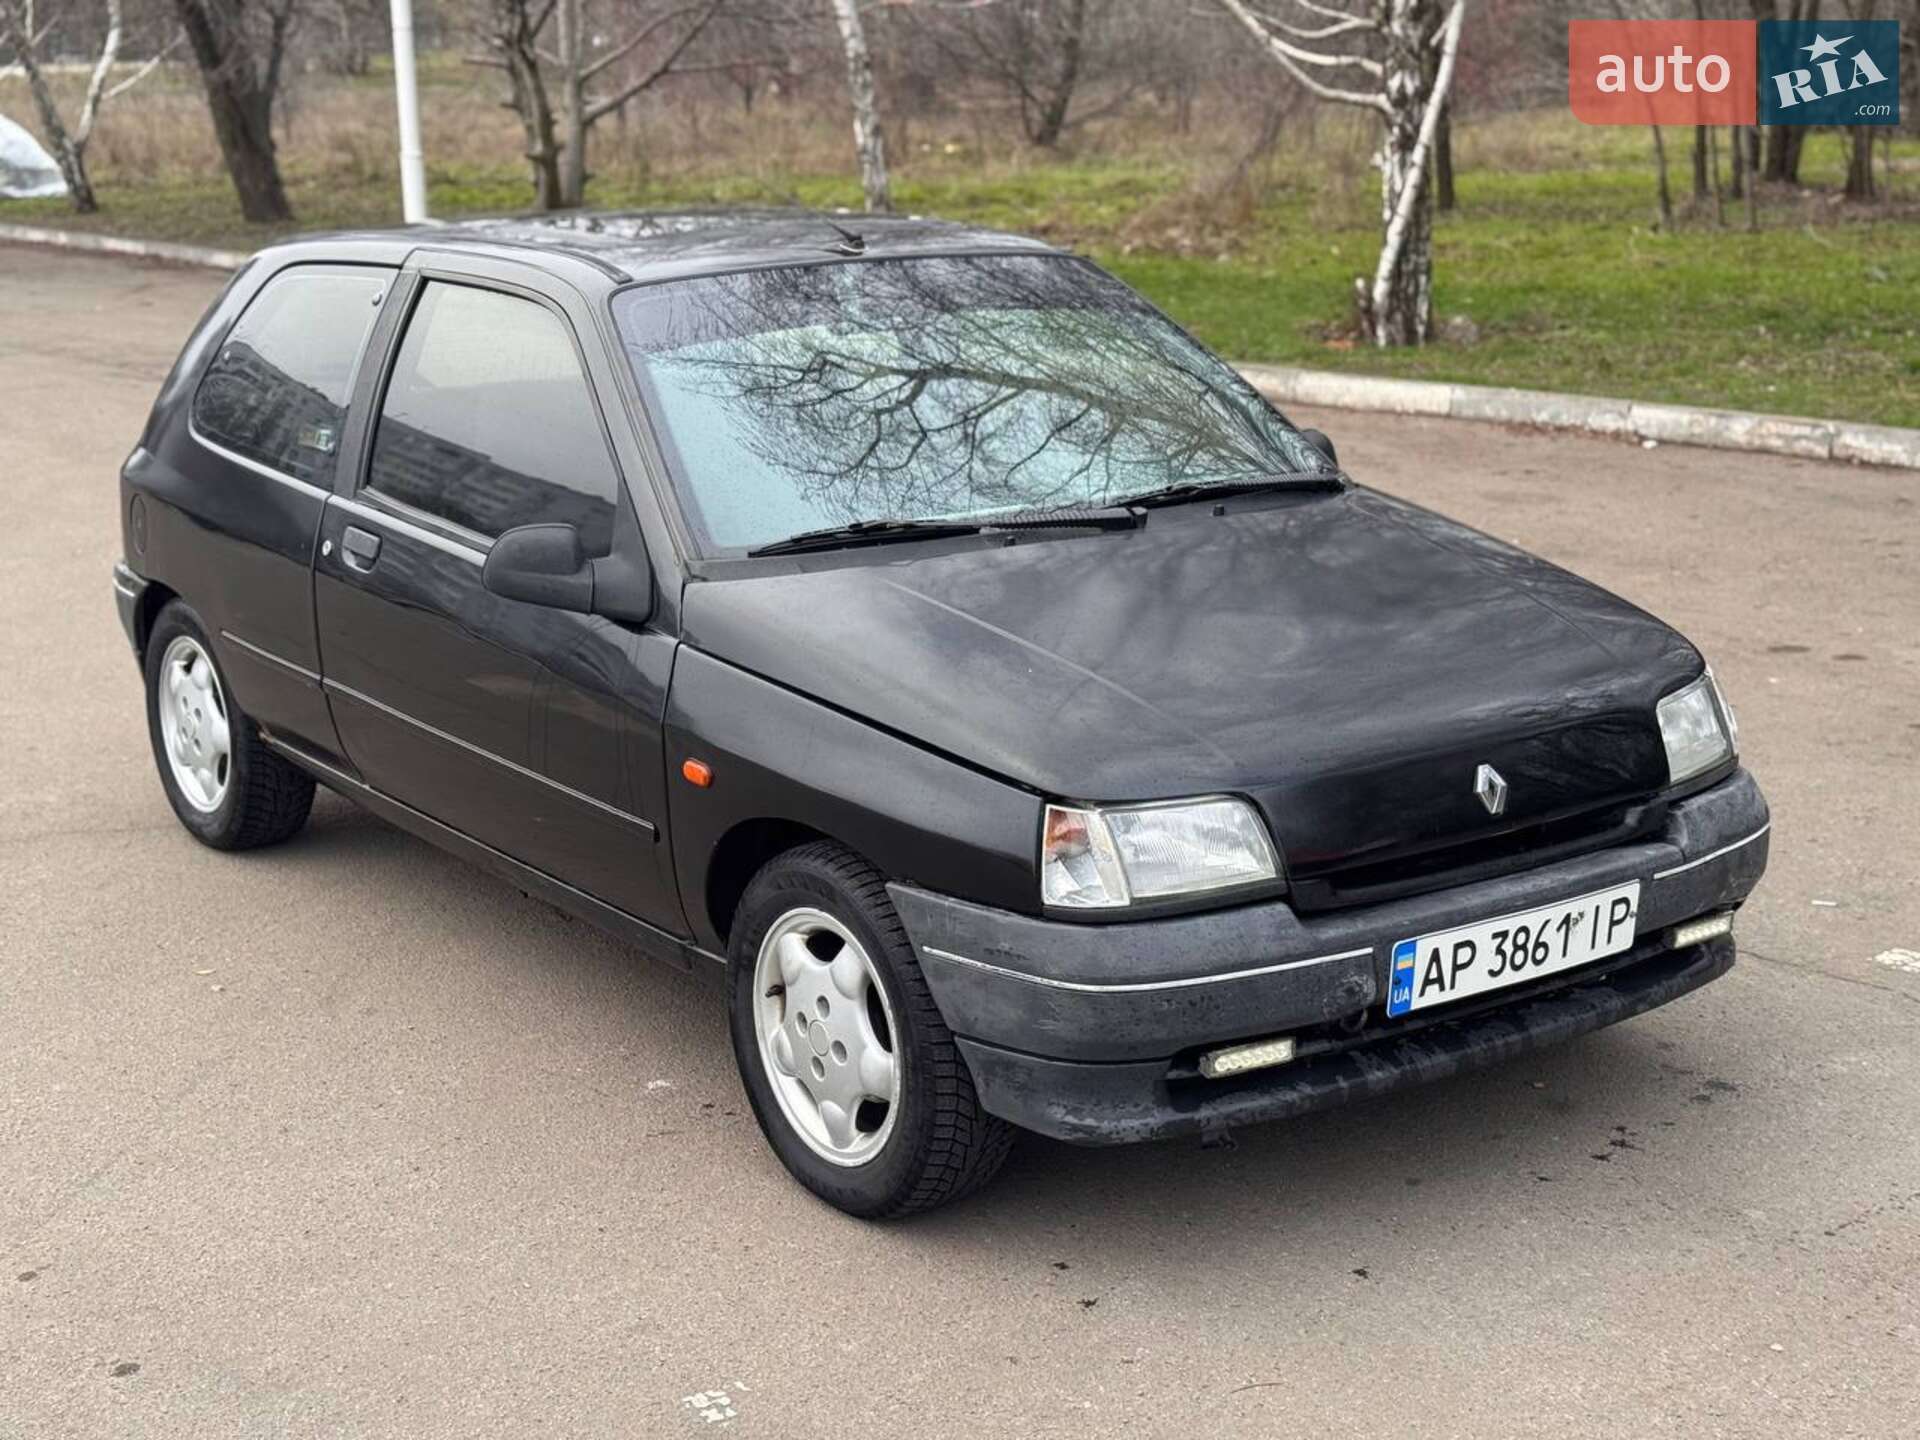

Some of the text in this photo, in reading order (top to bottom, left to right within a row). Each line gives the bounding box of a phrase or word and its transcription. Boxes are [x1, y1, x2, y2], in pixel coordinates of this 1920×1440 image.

[1418, 896, 1632, 998] AP 3861 IP
[1393, 987, 1410, 1004] UA
